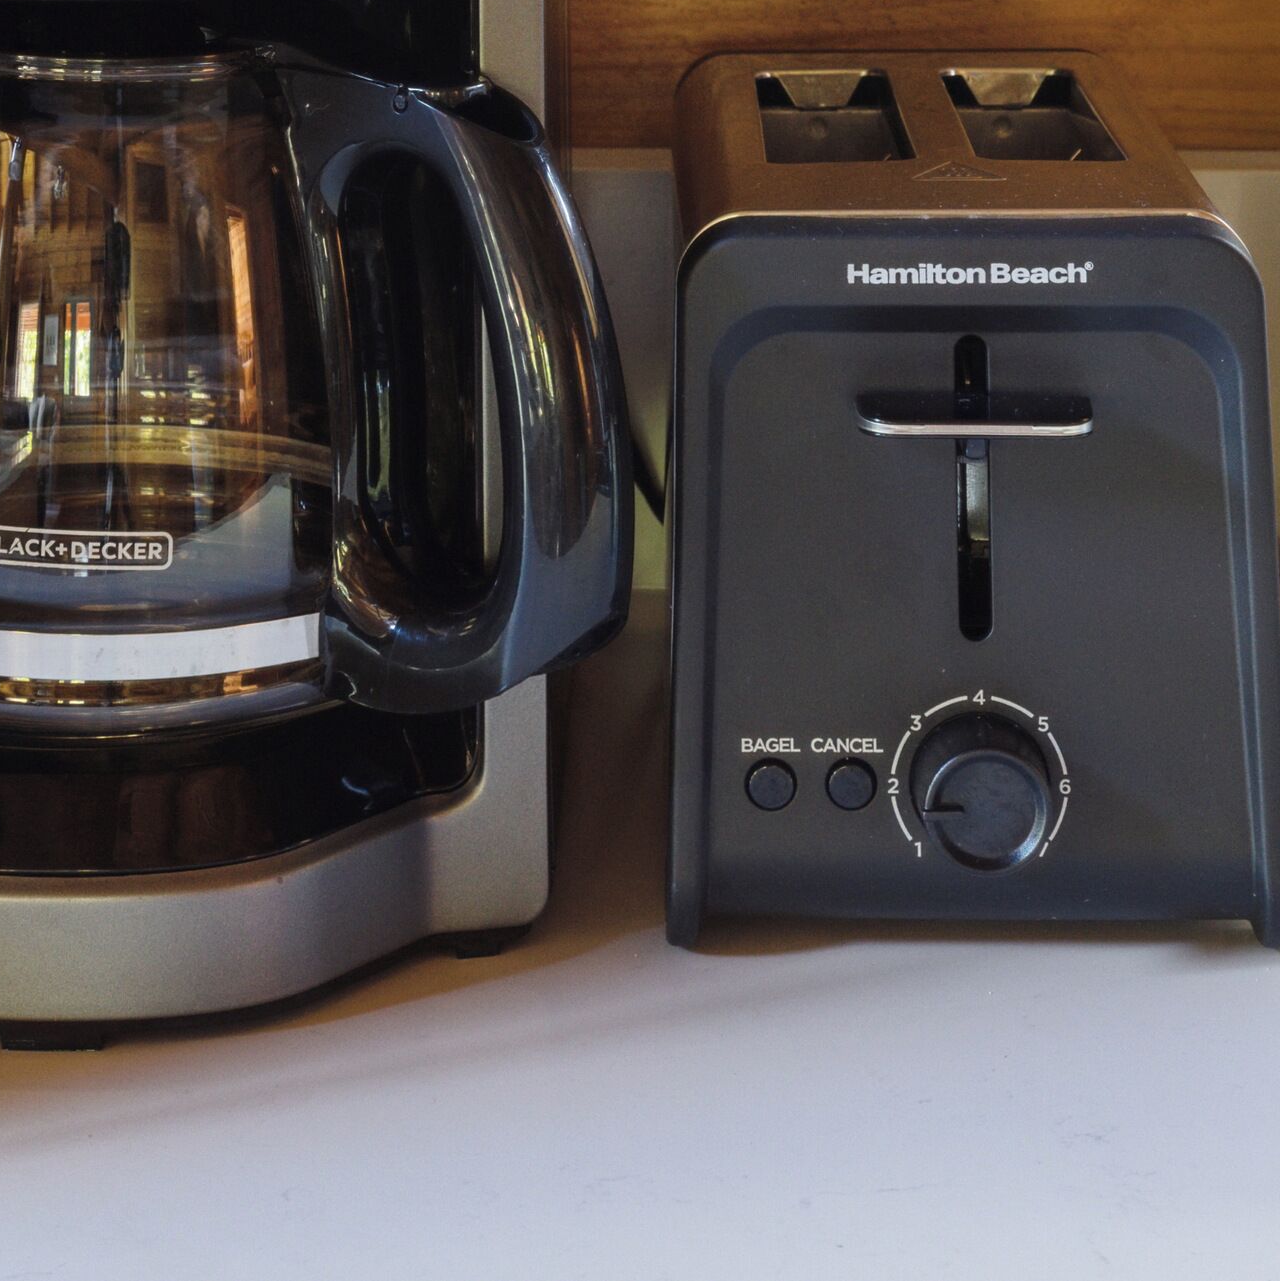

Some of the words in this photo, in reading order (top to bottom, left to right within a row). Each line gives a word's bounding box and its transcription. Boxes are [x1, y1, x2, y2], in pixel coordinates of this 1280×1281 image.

[847, 263, 986, 284] Hamilton
[972, 690, 986, 705] 4
[910, 715, 922, 732] 3
[1038, 717, 1049, 732] 5
[741, 738, 800, 753] BAGEL
[811, 738, 884, 753] CANCEL
[888, 779, 900, 794] 2
[1059, 779, 1071, 794] 6
[914, 843, 922, 857] 1
